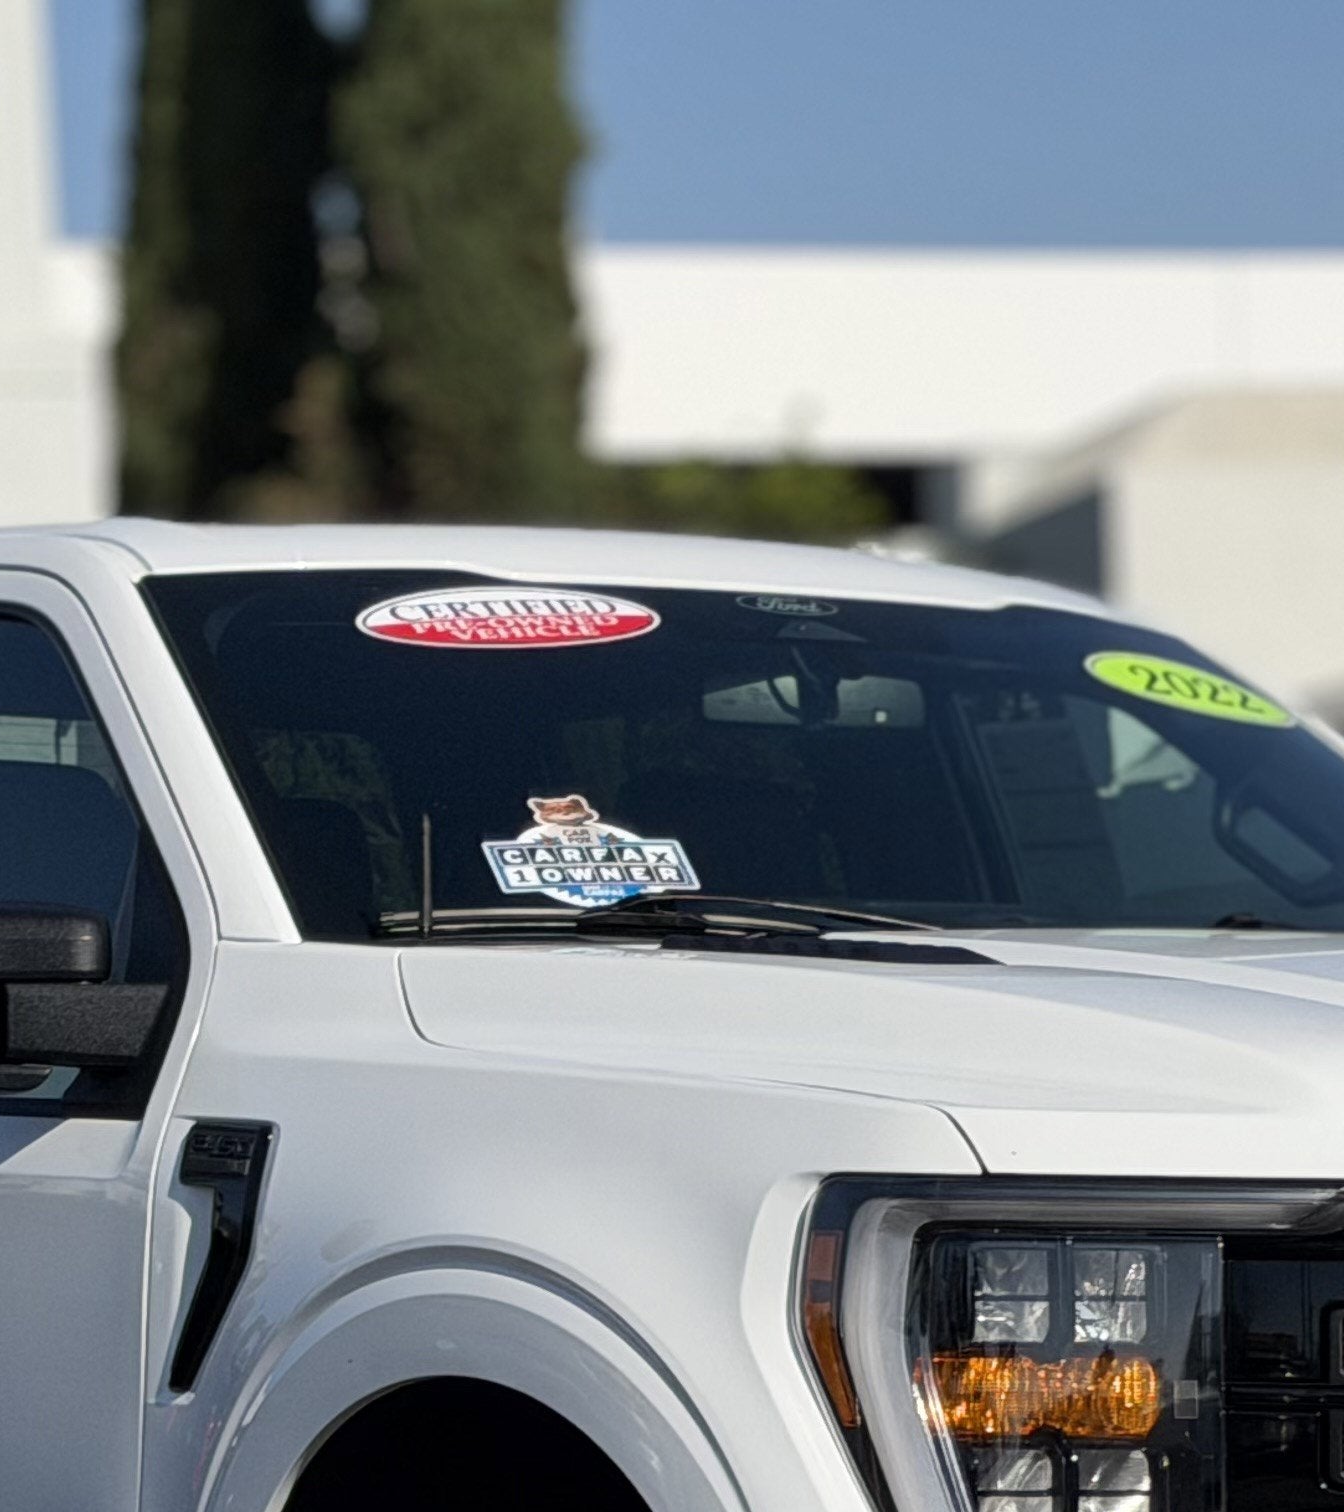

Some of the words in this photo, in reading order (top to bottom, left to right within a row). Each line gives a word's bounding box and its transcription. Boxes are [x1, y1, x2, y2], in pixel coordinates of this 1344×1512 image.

[389, 598, 617, 623] CERTIFIED
[411, 613, 619, 634] PRE-OWNED
[451, 626, 602, 640] VEHICLE
[1127, 664, 1266, 715] 2022
[502, 847, 674, 866] CARFAX
[542, 865, 682, 883] OWNER
